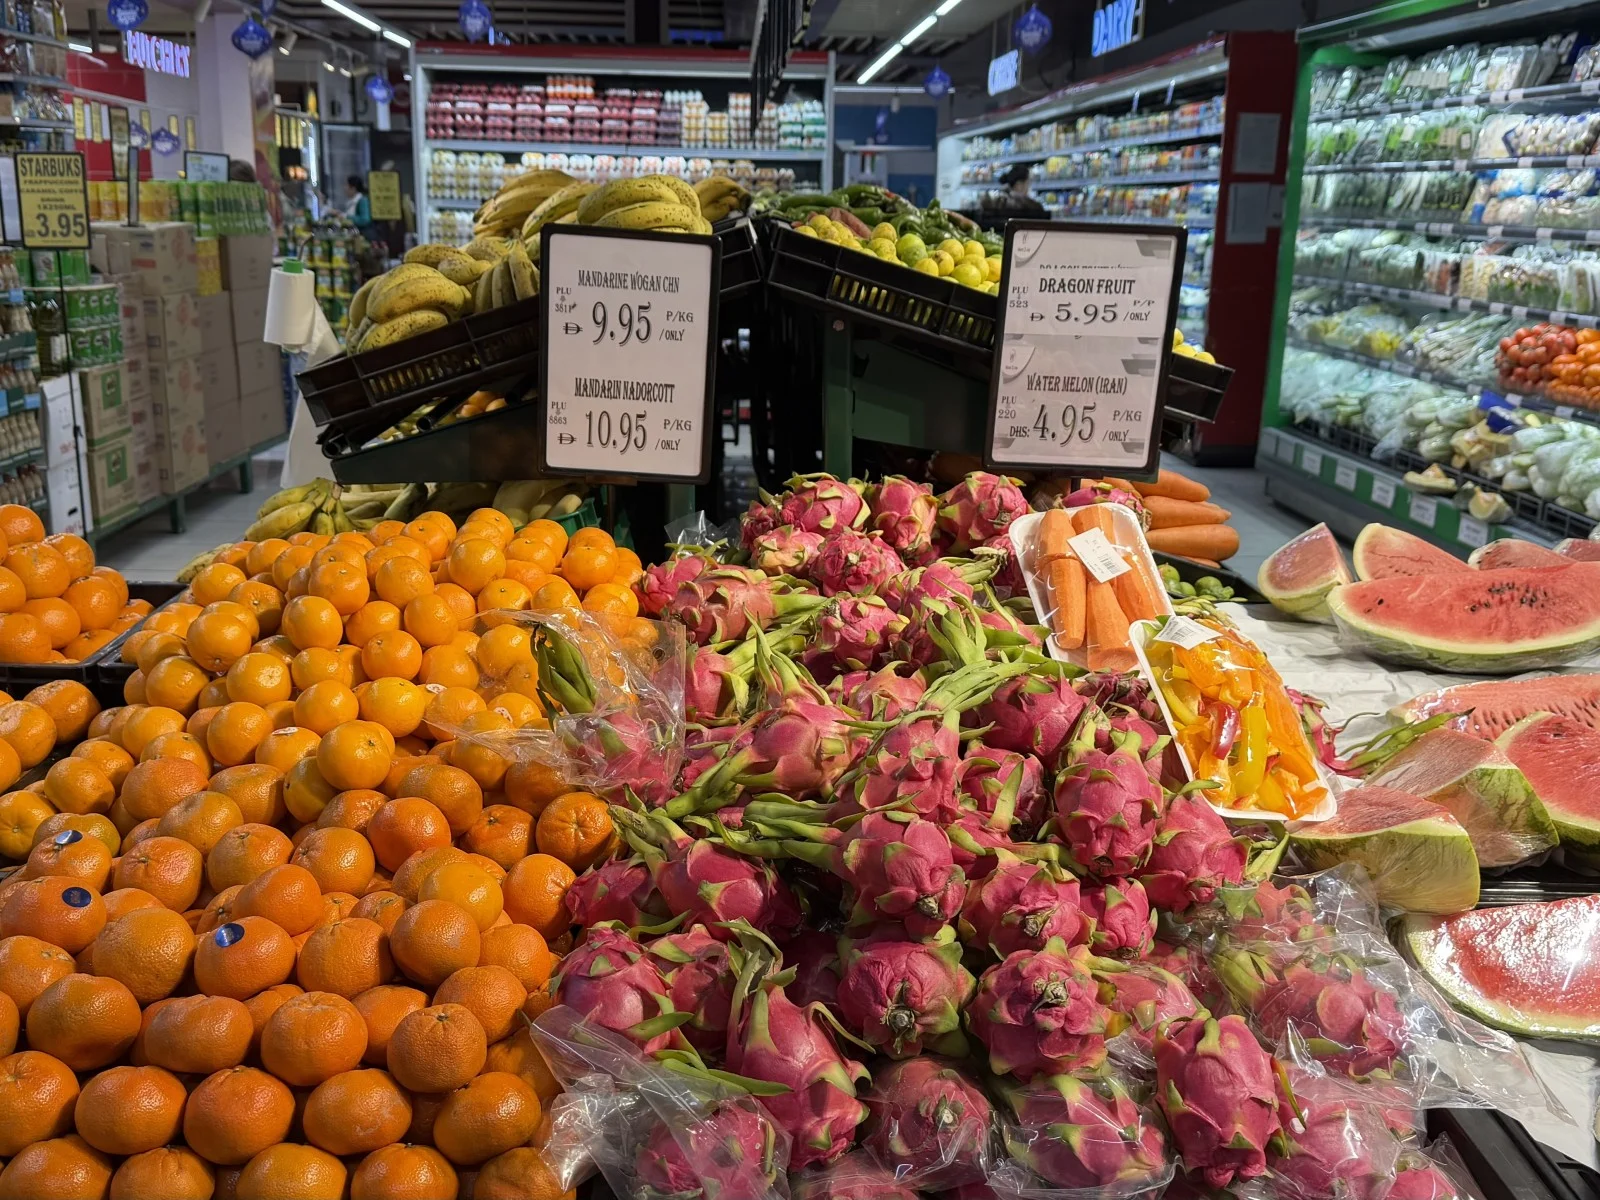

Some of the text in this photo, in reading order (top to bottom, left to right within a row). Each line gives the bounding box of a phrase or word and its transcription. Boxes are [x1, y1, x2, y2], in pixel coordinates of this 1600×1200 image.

[20, 157, 81, 176] STARBUKS
[36, 213, 85, 237] 3.95
[578, 270, 680, 293] MANDARINE WOGAN CHN
[1039, 278, 1136, 295] DRAGON FRUIT
[556, 286, 572, 295] PLU
[1012, 286, 1028, 294] PLU
[1009, 300, 1028, 308] 523
[666, 311, 694, 323] P/KG
[1055, 302, 1118, 325] 5.95
[592, 301, 651, 346] 9.95
[575, 377, 675, 403] MANDARIN NADORCOTT
[1027, 372, 1128, 395] WATER MELON (IRAN)
[551, 401, 567, 409] PLU
[1001, 396, 1017, 404] PLU
[549, 416, 567, 425] 8863
[998, 410, 1016, 419] 220
[1113, 410, 1142, 422] P/KG
[664, 419, 692, 431] P/KG
[1010, 402, 1097, 447] DHS: 4.95
[586, 410, 647, 455] 10.95
